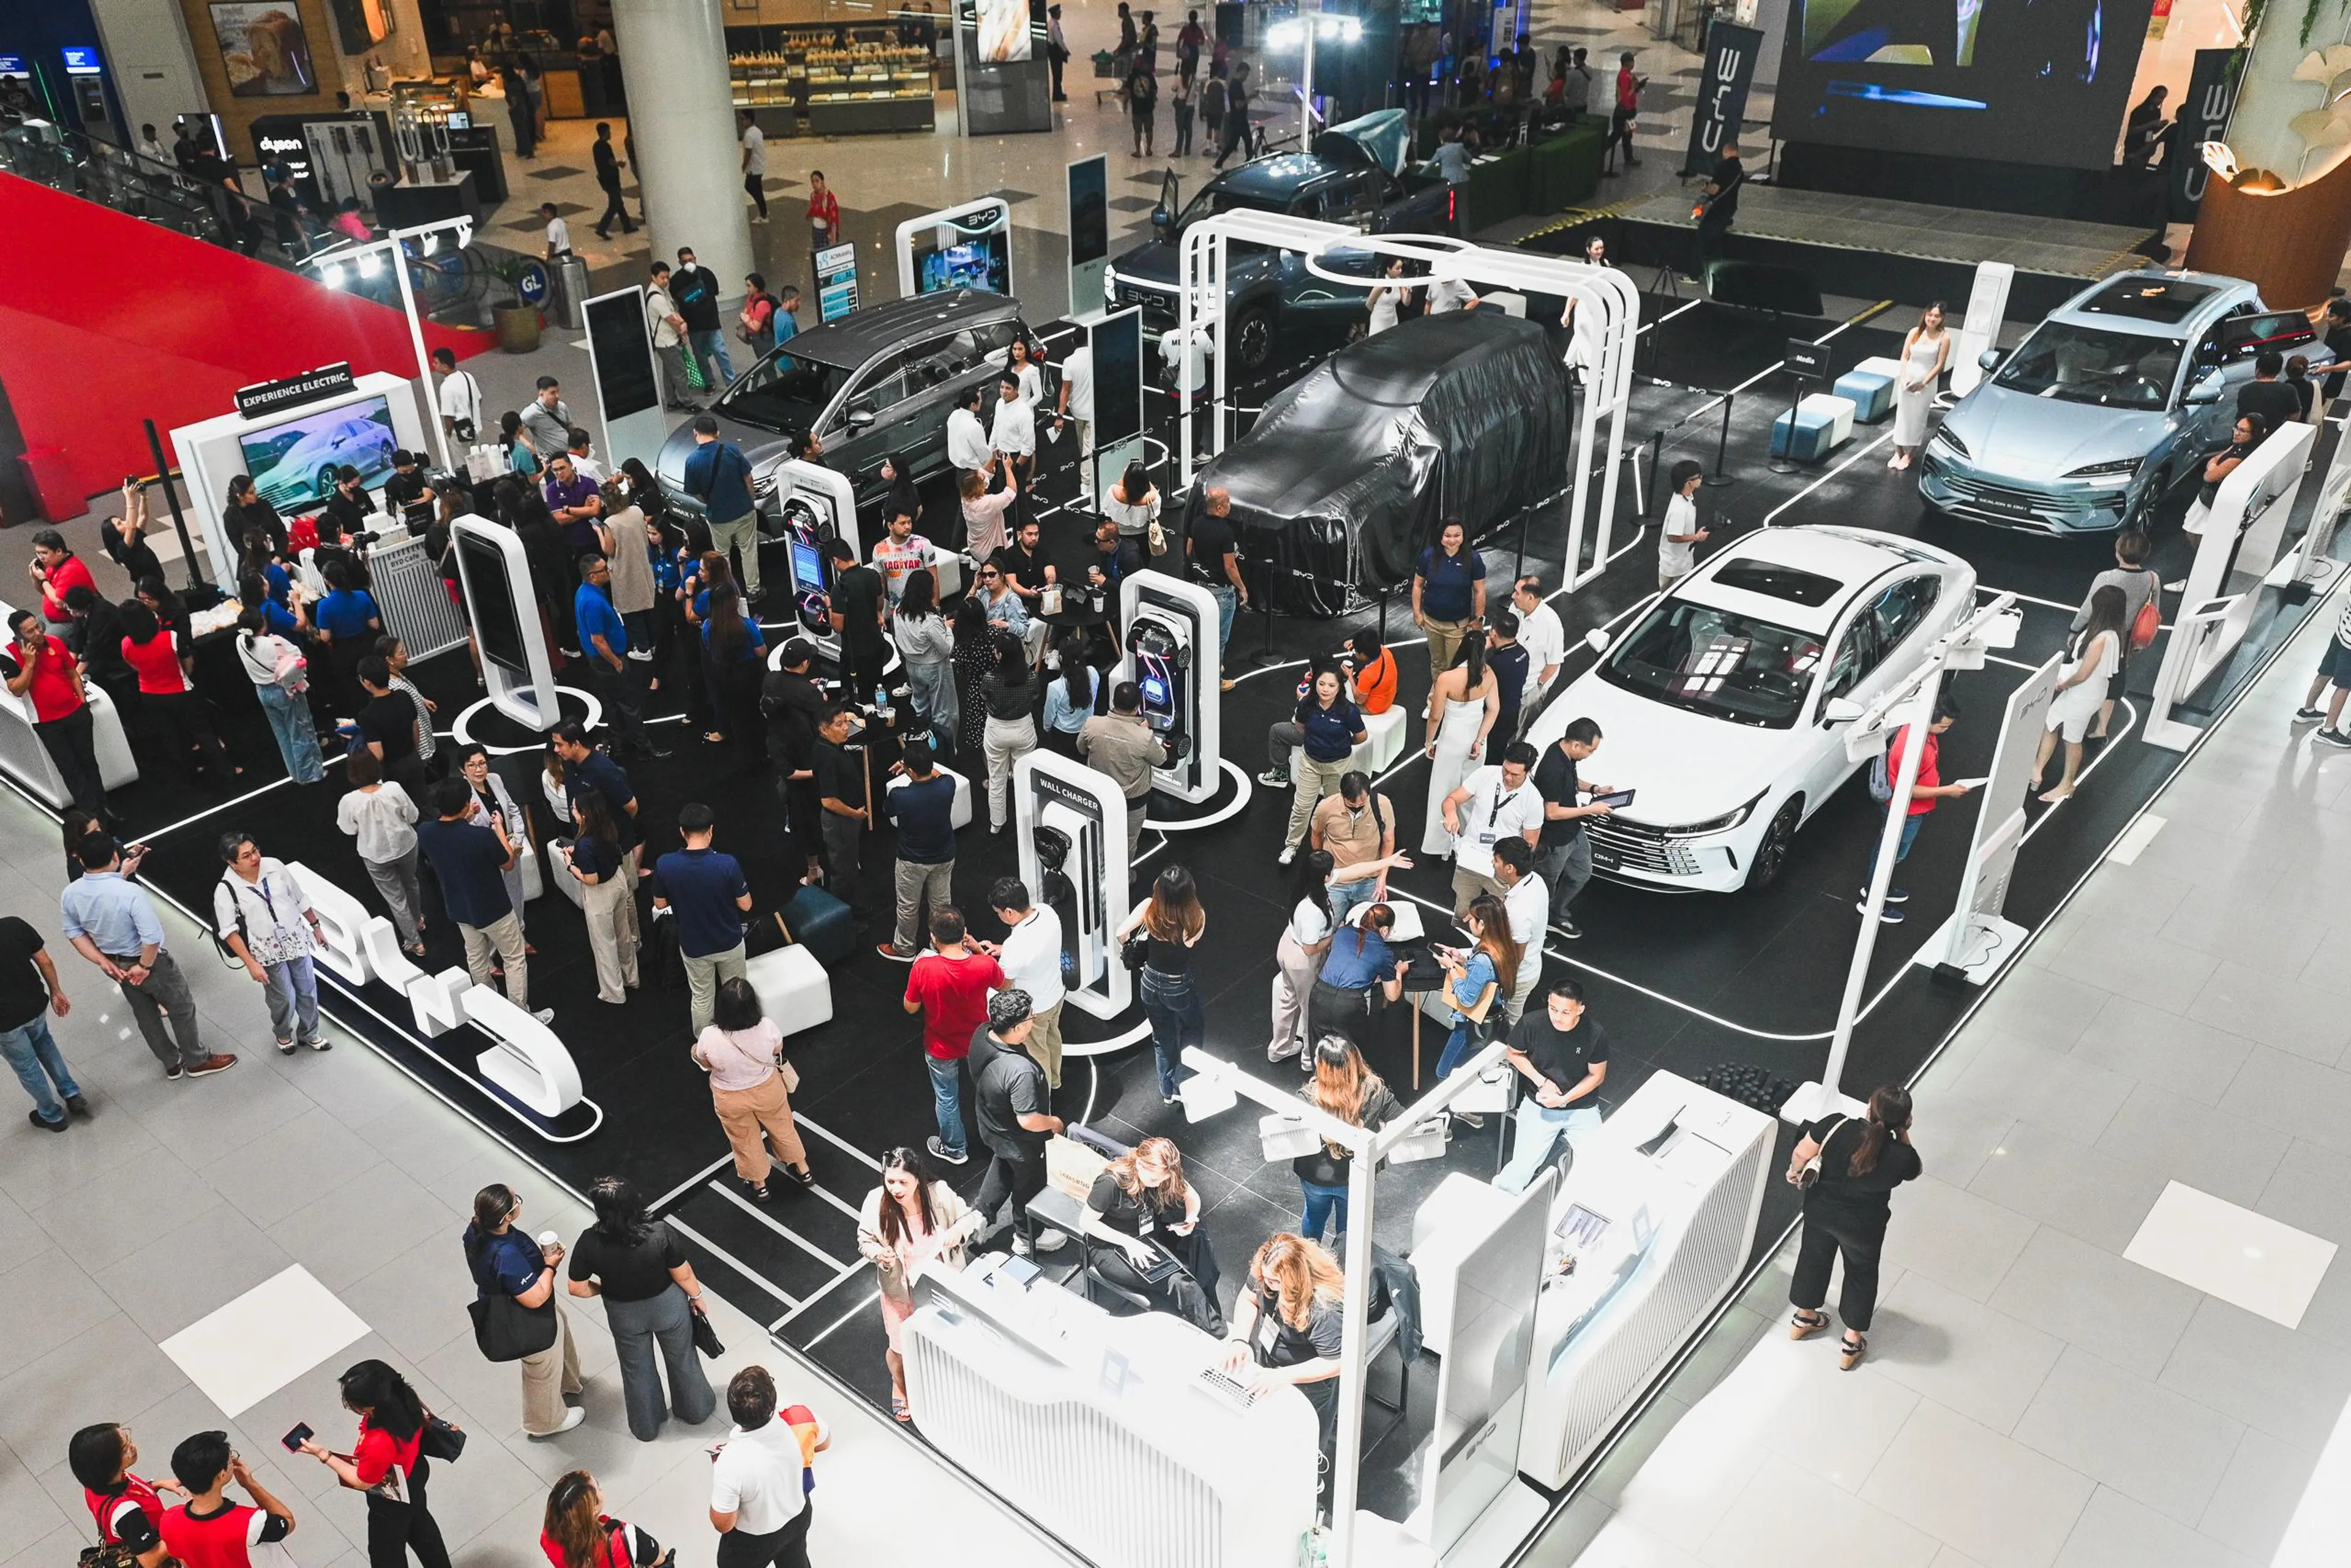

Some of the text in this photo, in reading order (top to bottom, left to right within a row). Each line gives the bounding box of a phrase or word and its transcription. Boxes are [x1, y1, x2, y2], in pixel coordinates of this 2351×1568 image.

[260, 137, 302, 153] dyson
[968, 210, 997, 226] BYD
[522, 275, 541, 292] GL
[1127, 290, 1165, 307] BYD
[1652, 377, 1671, 387] BYD
[242, 372, 349, 407] EXPERIENCE ELECTRIC.
[1687, 386, 1706, 395] BYD
[1559, 484, 1573, 496] BYD
[1536, 498, 1550, 509] BYD
[1496, 520, 1510, 532] BYD
[1472, 534, 1487, 546] BYD
[1292, 569, 1314, 580] BYD
[1333, 580, 1355, 590] BYD
[1040, 778, 1098, 811] WALL CHARGER
[1466, 1422, 1497, 1460] BYD
